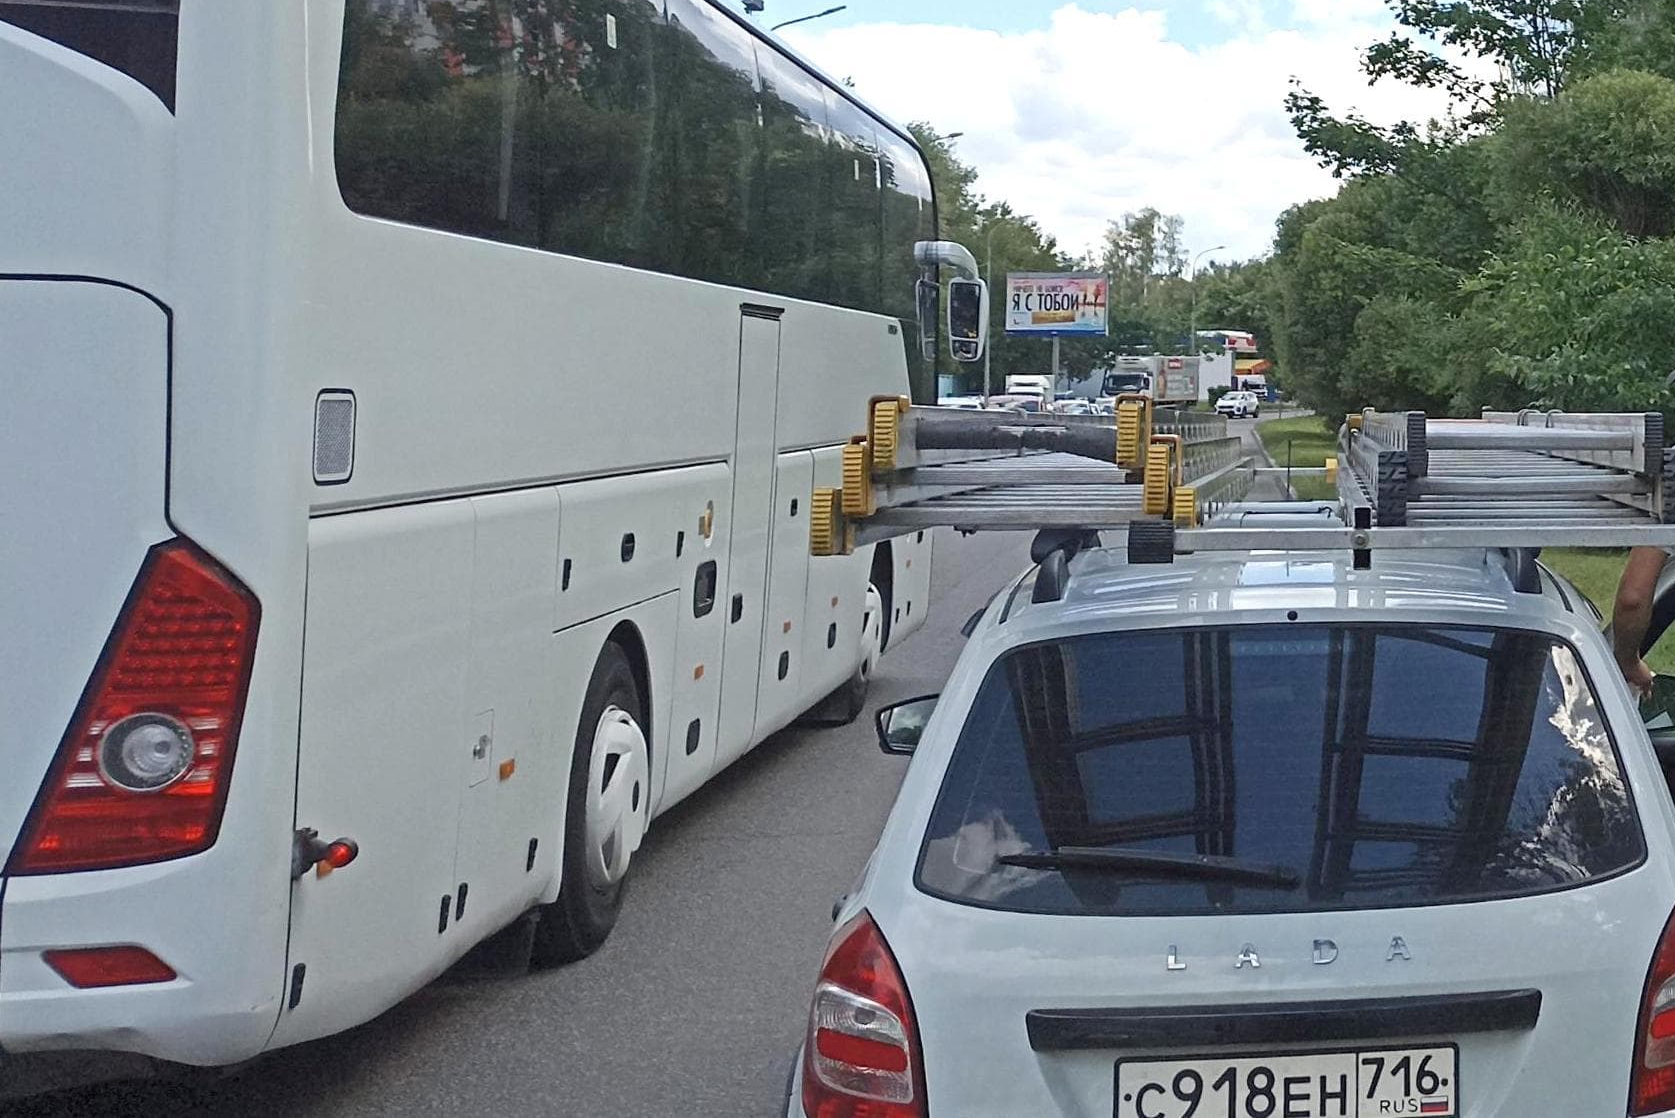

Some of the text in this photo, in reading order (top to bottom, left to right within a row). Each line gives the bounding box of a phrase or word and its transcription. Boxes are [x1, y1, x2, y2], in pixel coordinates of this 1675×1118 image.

[1012, 293, 1020, 311] Я
[1025, 293, 1032, 312] С
[1165, 935, 1411, 971] LADA
[1362, 1054, 1440, 1099] 716
[1380, 1098, 1419, 1114] RUS
